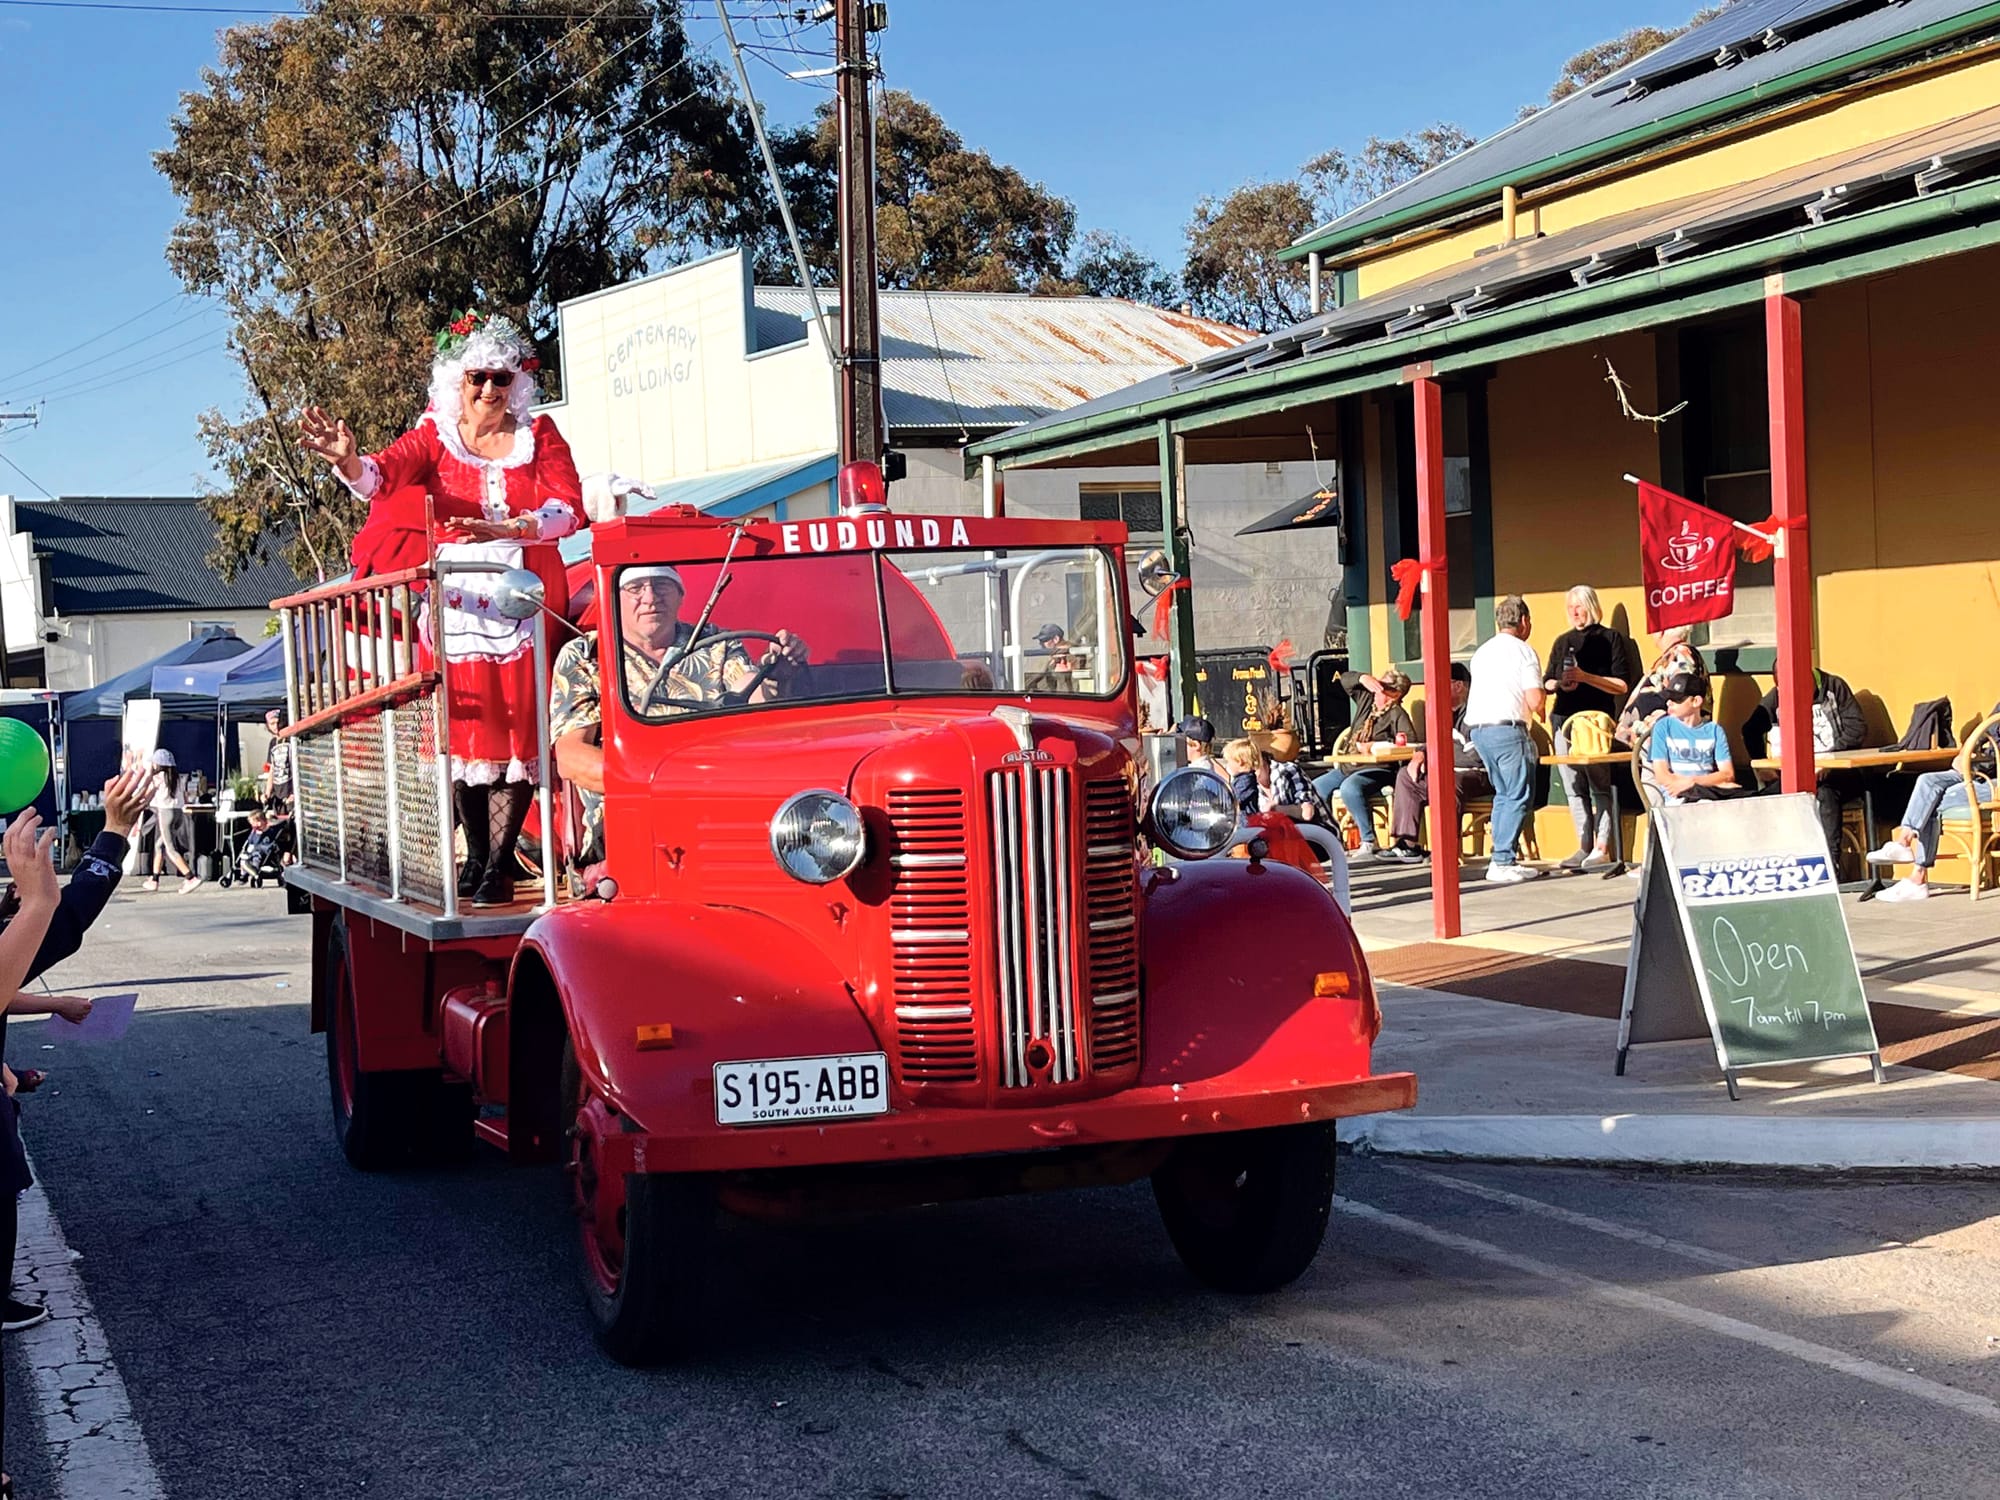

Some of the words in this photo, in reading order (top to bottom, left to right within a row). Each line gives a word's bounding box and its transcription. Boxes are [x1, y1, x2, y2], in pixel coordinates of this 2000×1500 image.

[607, 323, 697, 373] CENTENARY
[782, 518, 970, 552] EUDUNDA
[1650, 576, 1729, 608] COFFEE
[1683, 864, 1826, 898] BAKERY
[1698, 855, 1797, 874] EUDUNDA
[1713, 916, 1809, 986] Open
[752, 1109, 790, 1119] SOUTH
[794, 1104, 855, 1117] AUSTRALIA
